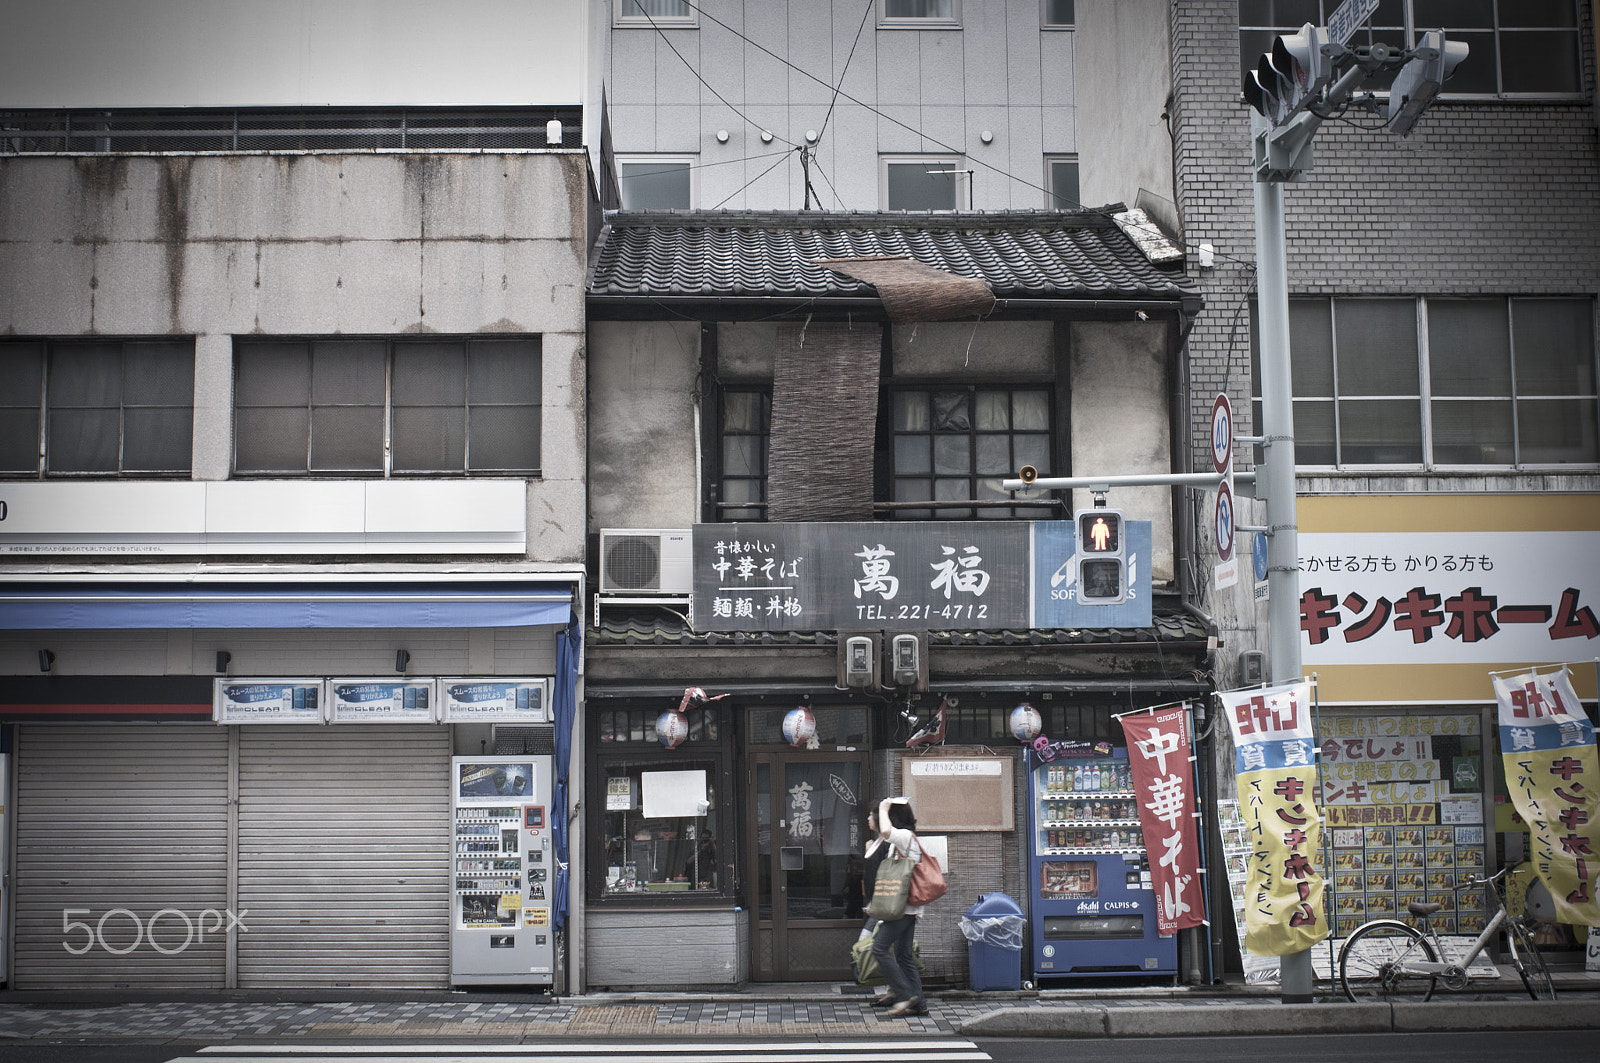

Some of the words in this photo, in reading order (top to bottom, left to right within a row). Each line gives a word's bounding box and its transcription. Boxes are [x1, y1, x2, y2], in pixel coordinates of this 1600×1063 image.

[1215, 416, 1228, 452] 40
[714, 540, 776, 555] 昔懐かしい
[1404, 554, 1494, 572] かりる方も
[712, 555, 804, 582] 中華そば
[853, 543, 990, 600] 萬福
[788, 781, 814, 837] 萬福
[1134, 727, 1192, 920] 中華そば
[1077, 901, 1100, 911] Asahi
[1104, 901, 1130, 911] CALPIS
